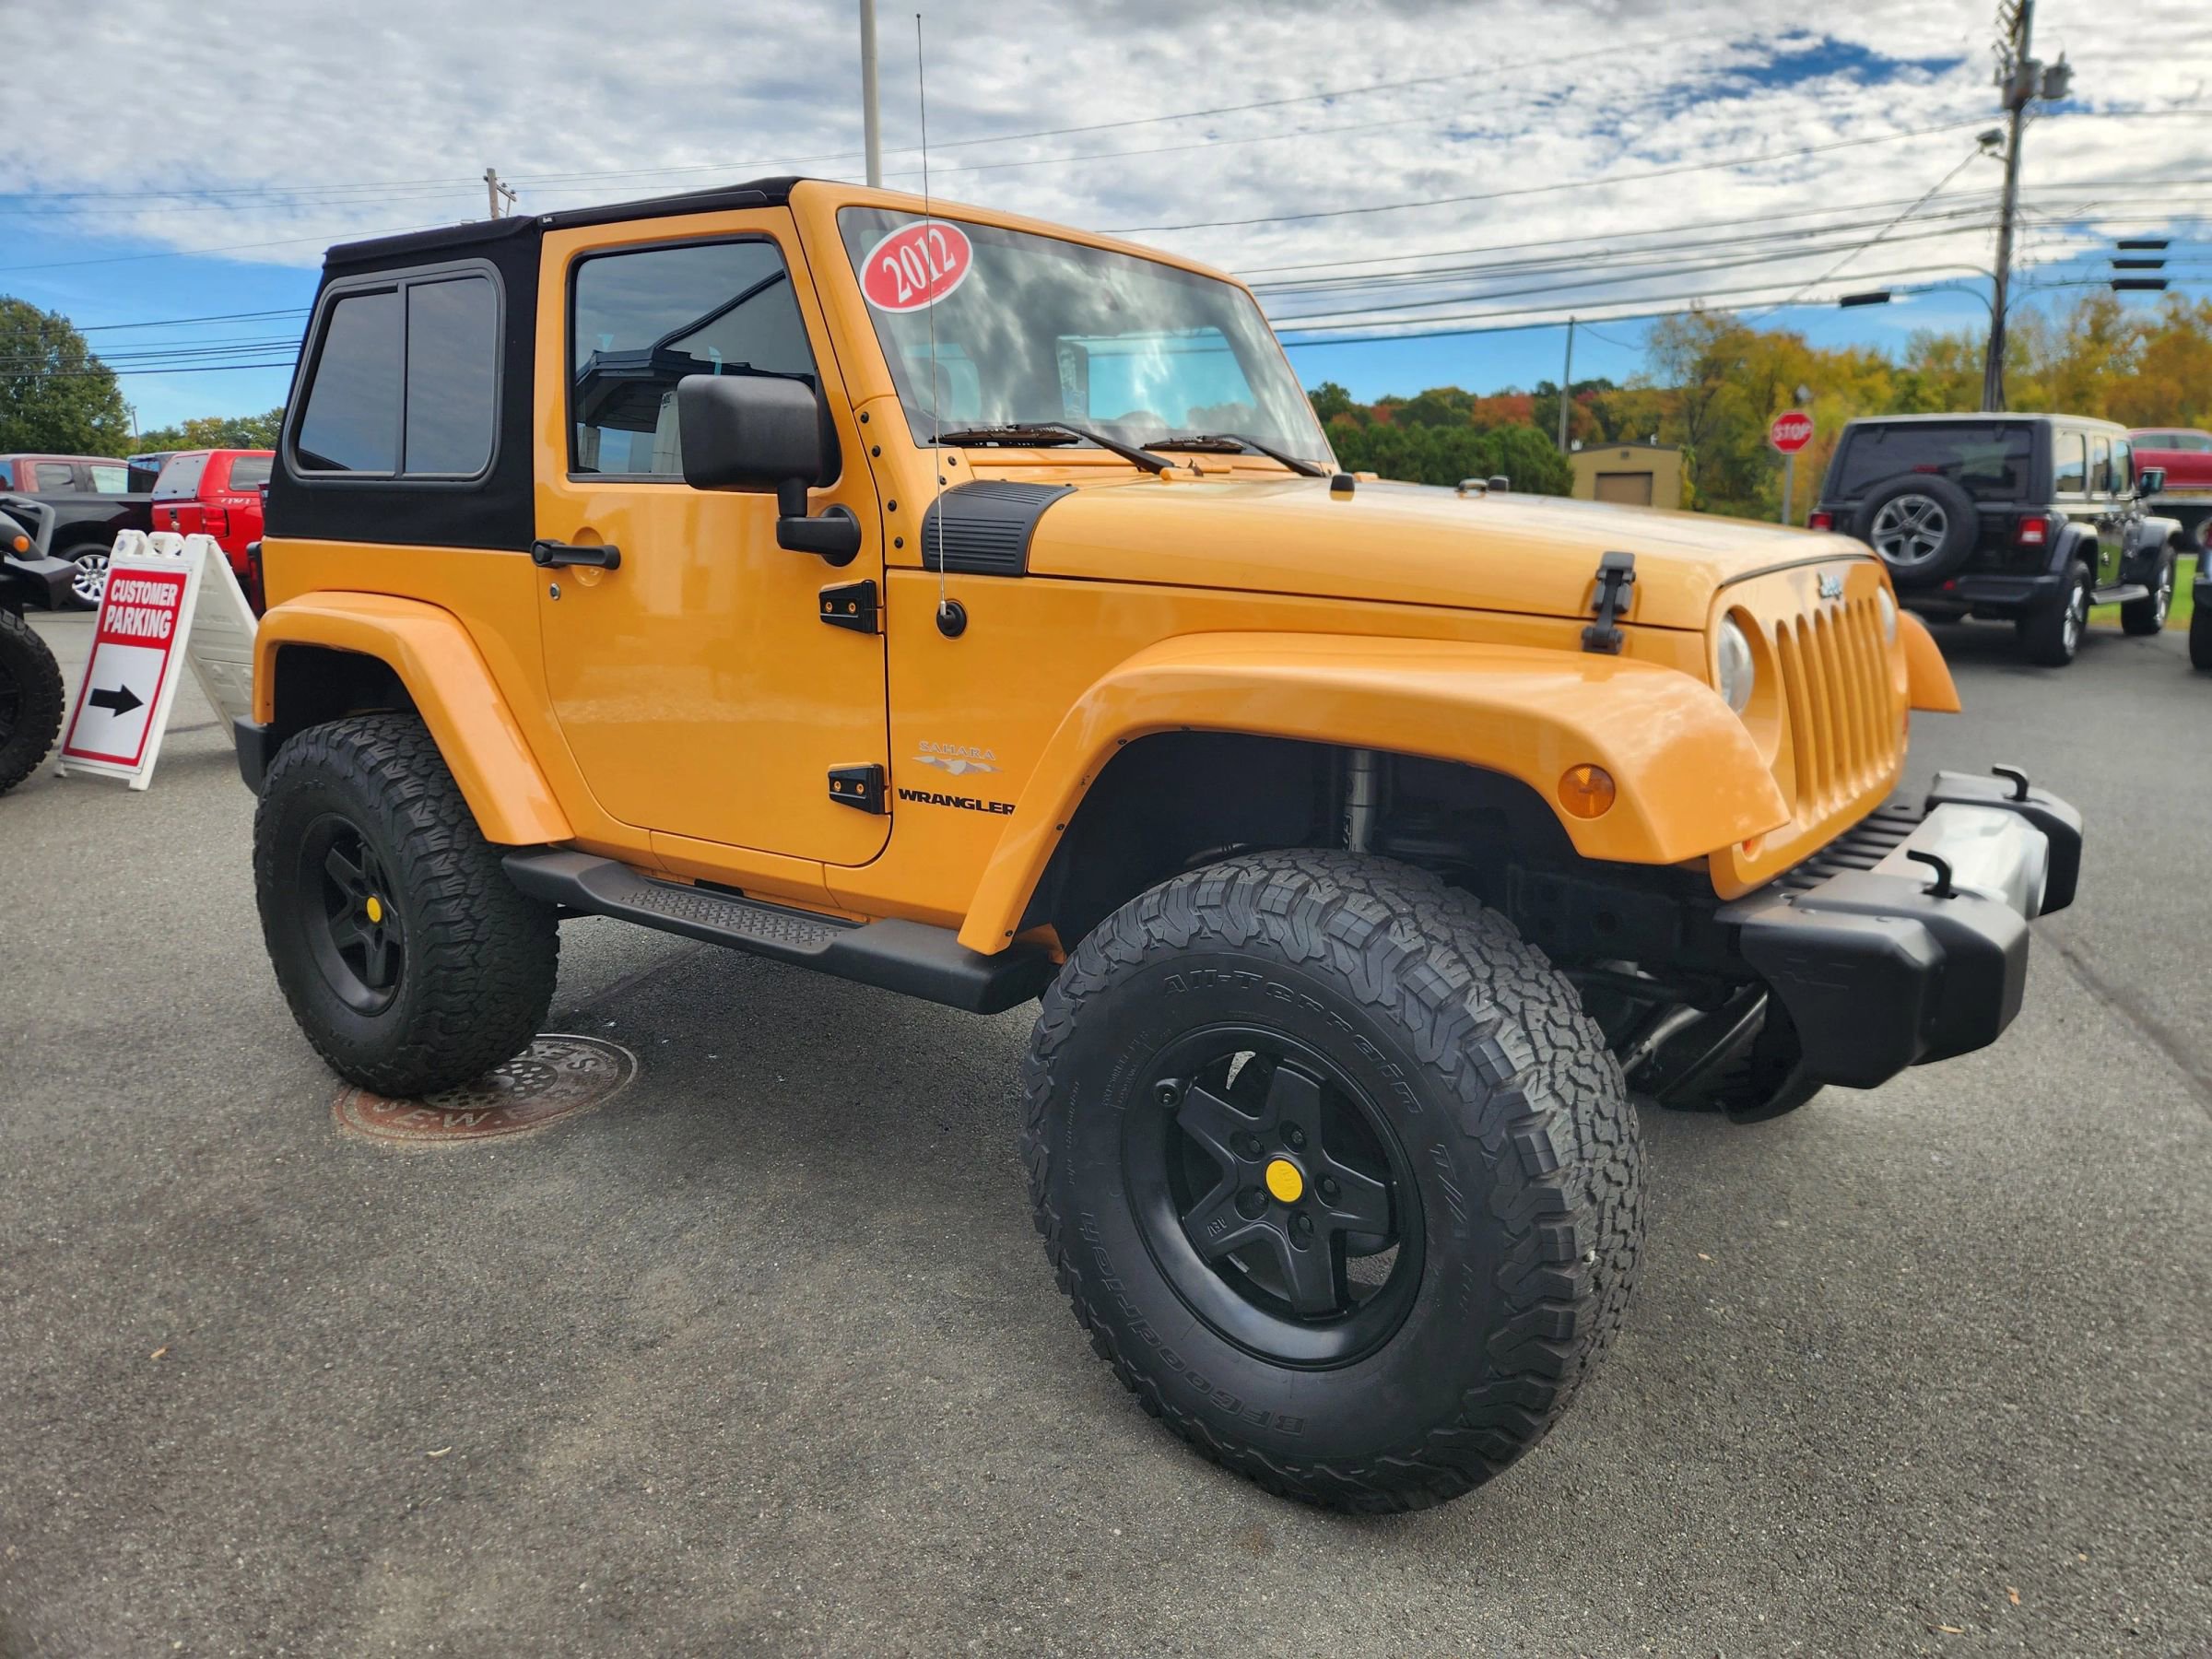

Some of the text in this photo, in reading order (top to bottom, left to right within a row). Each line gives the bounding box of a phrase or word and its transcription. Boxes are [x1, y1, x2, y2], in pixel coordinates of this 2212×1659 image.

[882, 228, 957, 304] 2012
[1772, 422, 1811, 441] STOP
[111, 579, 178, 606] CUSTOMER
[103, 605, 172, 639] PARKING
[919, 741, 996, 761] SAHARA
[898, 787, 1017, 816] WRANGLER
[1079, 1212, 1306, 1439] BFGoodrich
